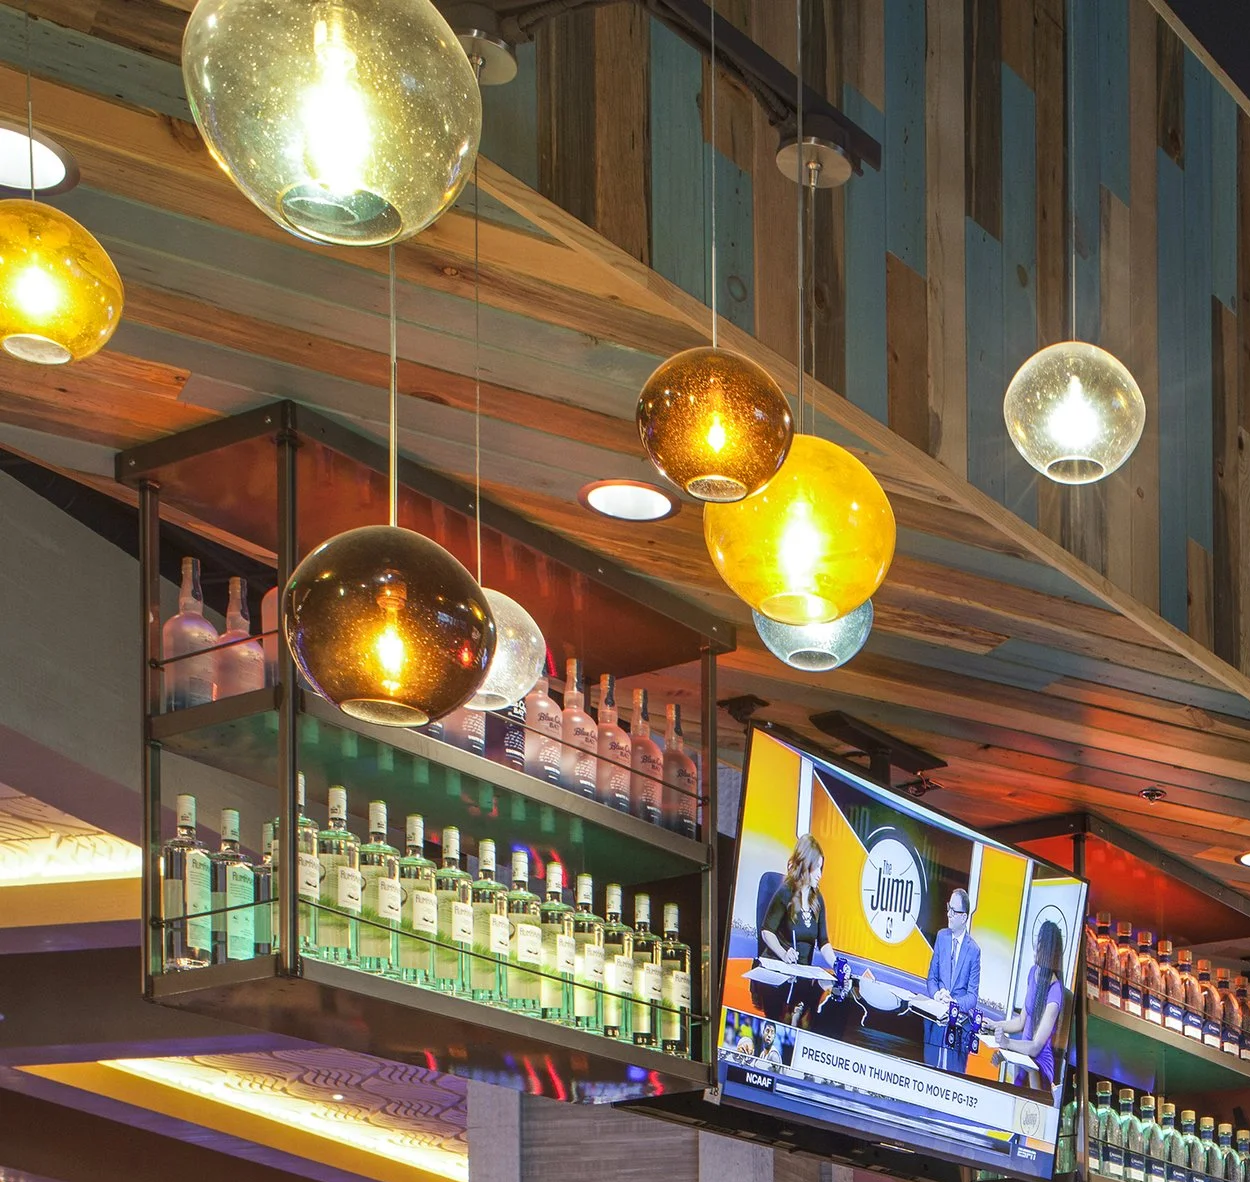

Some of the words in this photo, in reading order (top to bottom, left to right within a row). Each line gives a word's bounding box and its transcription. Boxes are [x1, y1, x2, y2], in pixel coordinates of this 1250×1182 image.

[883, 860, 893, 876] The
[870, 867, 914, 922] Jump
[746, 1072, 772, 1088] NCAAF
[801, 1046, 850, 1071] PRESSURE
[852, 1061, 867, 1077] ON
[868, 1066, 911, 1089] THUNDER
[912, 1079, 925, 1093] TO
[925, 1083, 951, 1101] MOVE
[952, 1091, 978, 1109] PG-13?
[1017, 1147, 1036, 1160] ESPN
